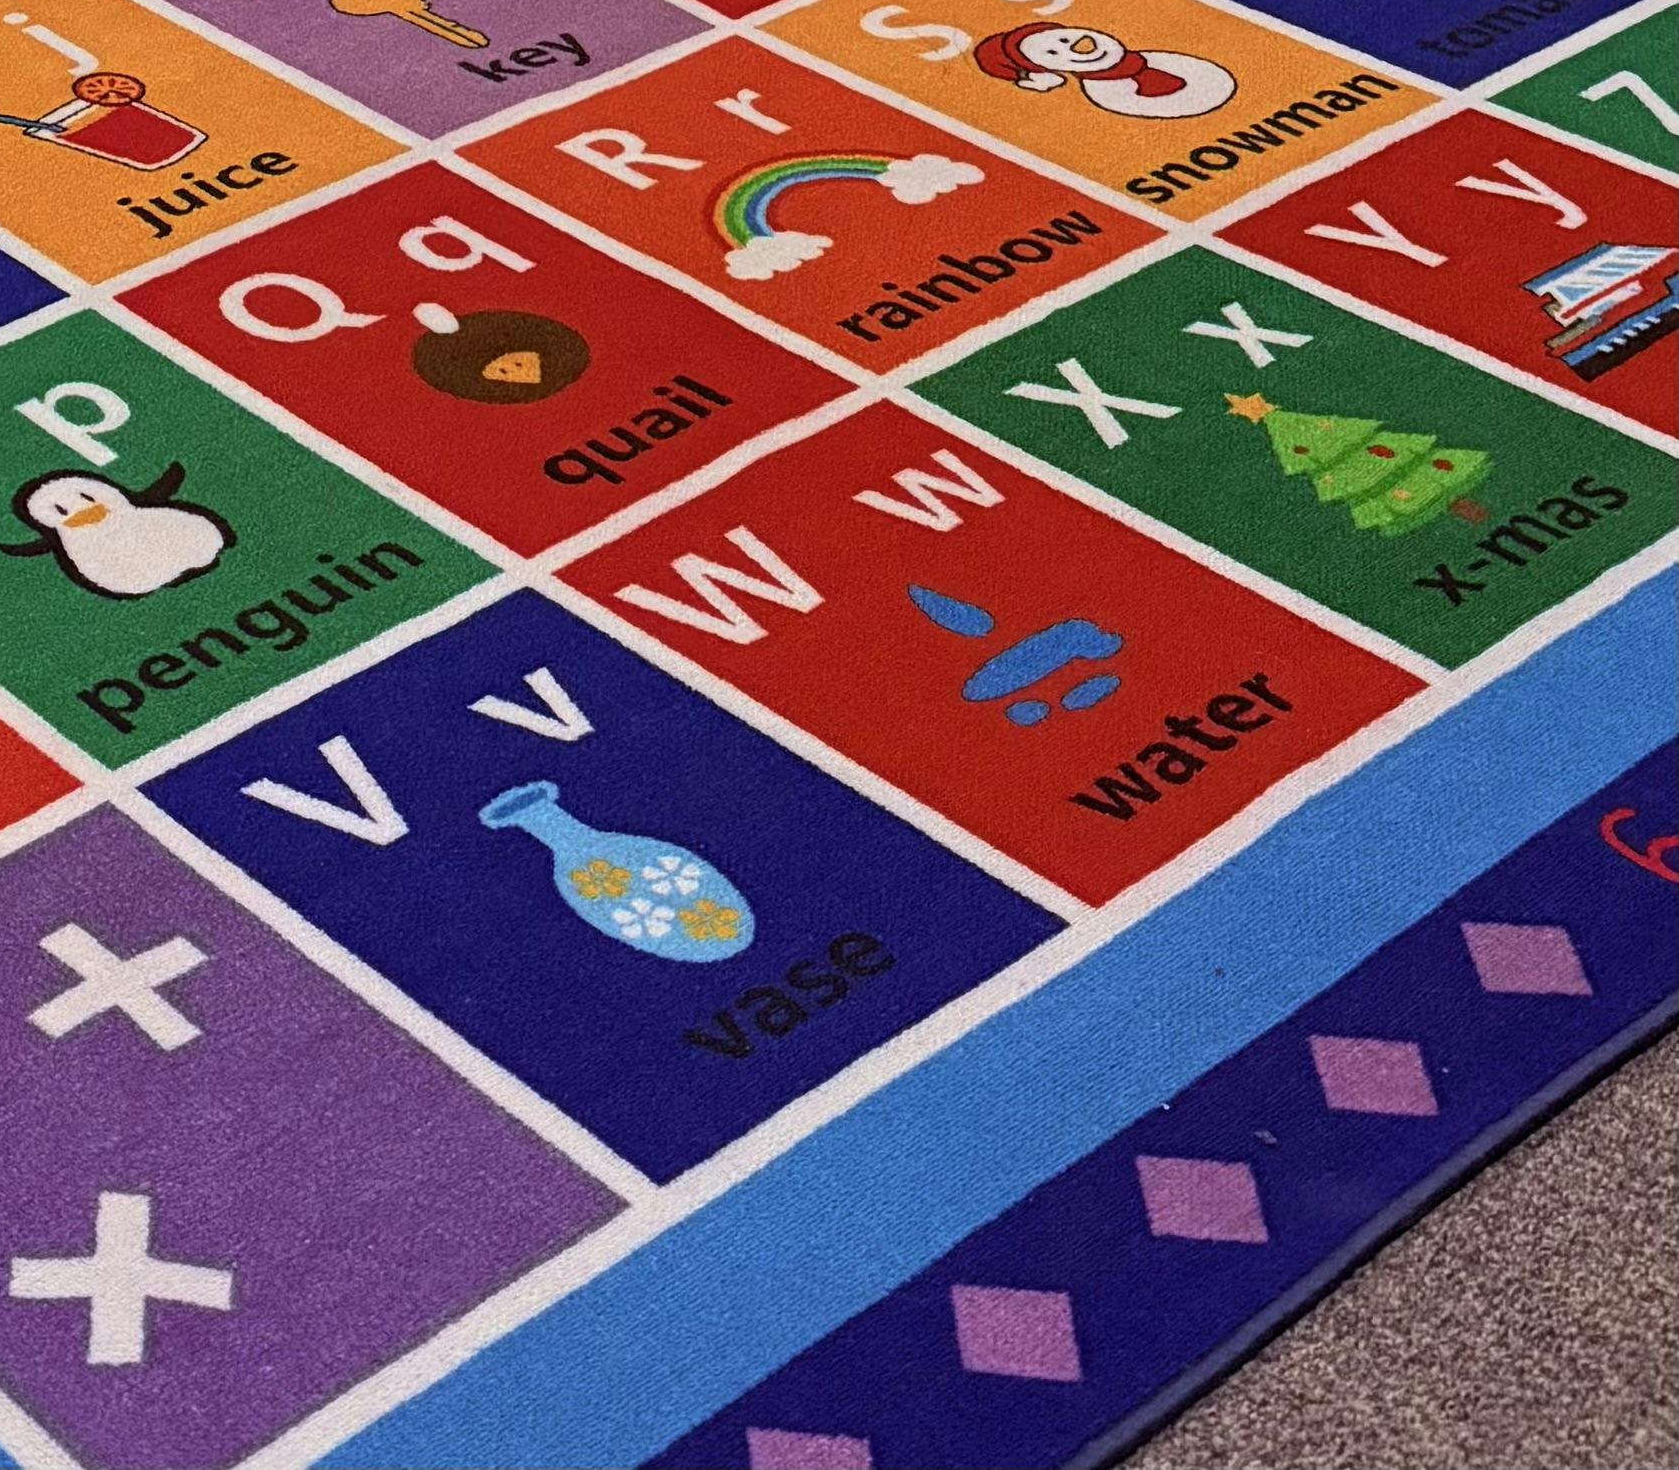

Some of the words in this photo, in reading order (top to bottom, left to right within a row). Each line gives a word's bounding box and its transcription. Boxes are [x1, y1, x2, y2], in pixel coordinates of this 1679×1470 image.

[458, 27, 595, 89] key
[114, 146, 299, 241] juice
[1121, 67, 1401, 209] snowman
[834, 207, 1106, 346] rainbow
[12, 381, 132, 467] p
[541, 371, 735, 491] quail
[1409, 467, 1633, 609] x-mas
[71, 530, 427, 735] penguin
[1064, 669, 1297, 826] water
[677, 926, 899, 1064] vase
